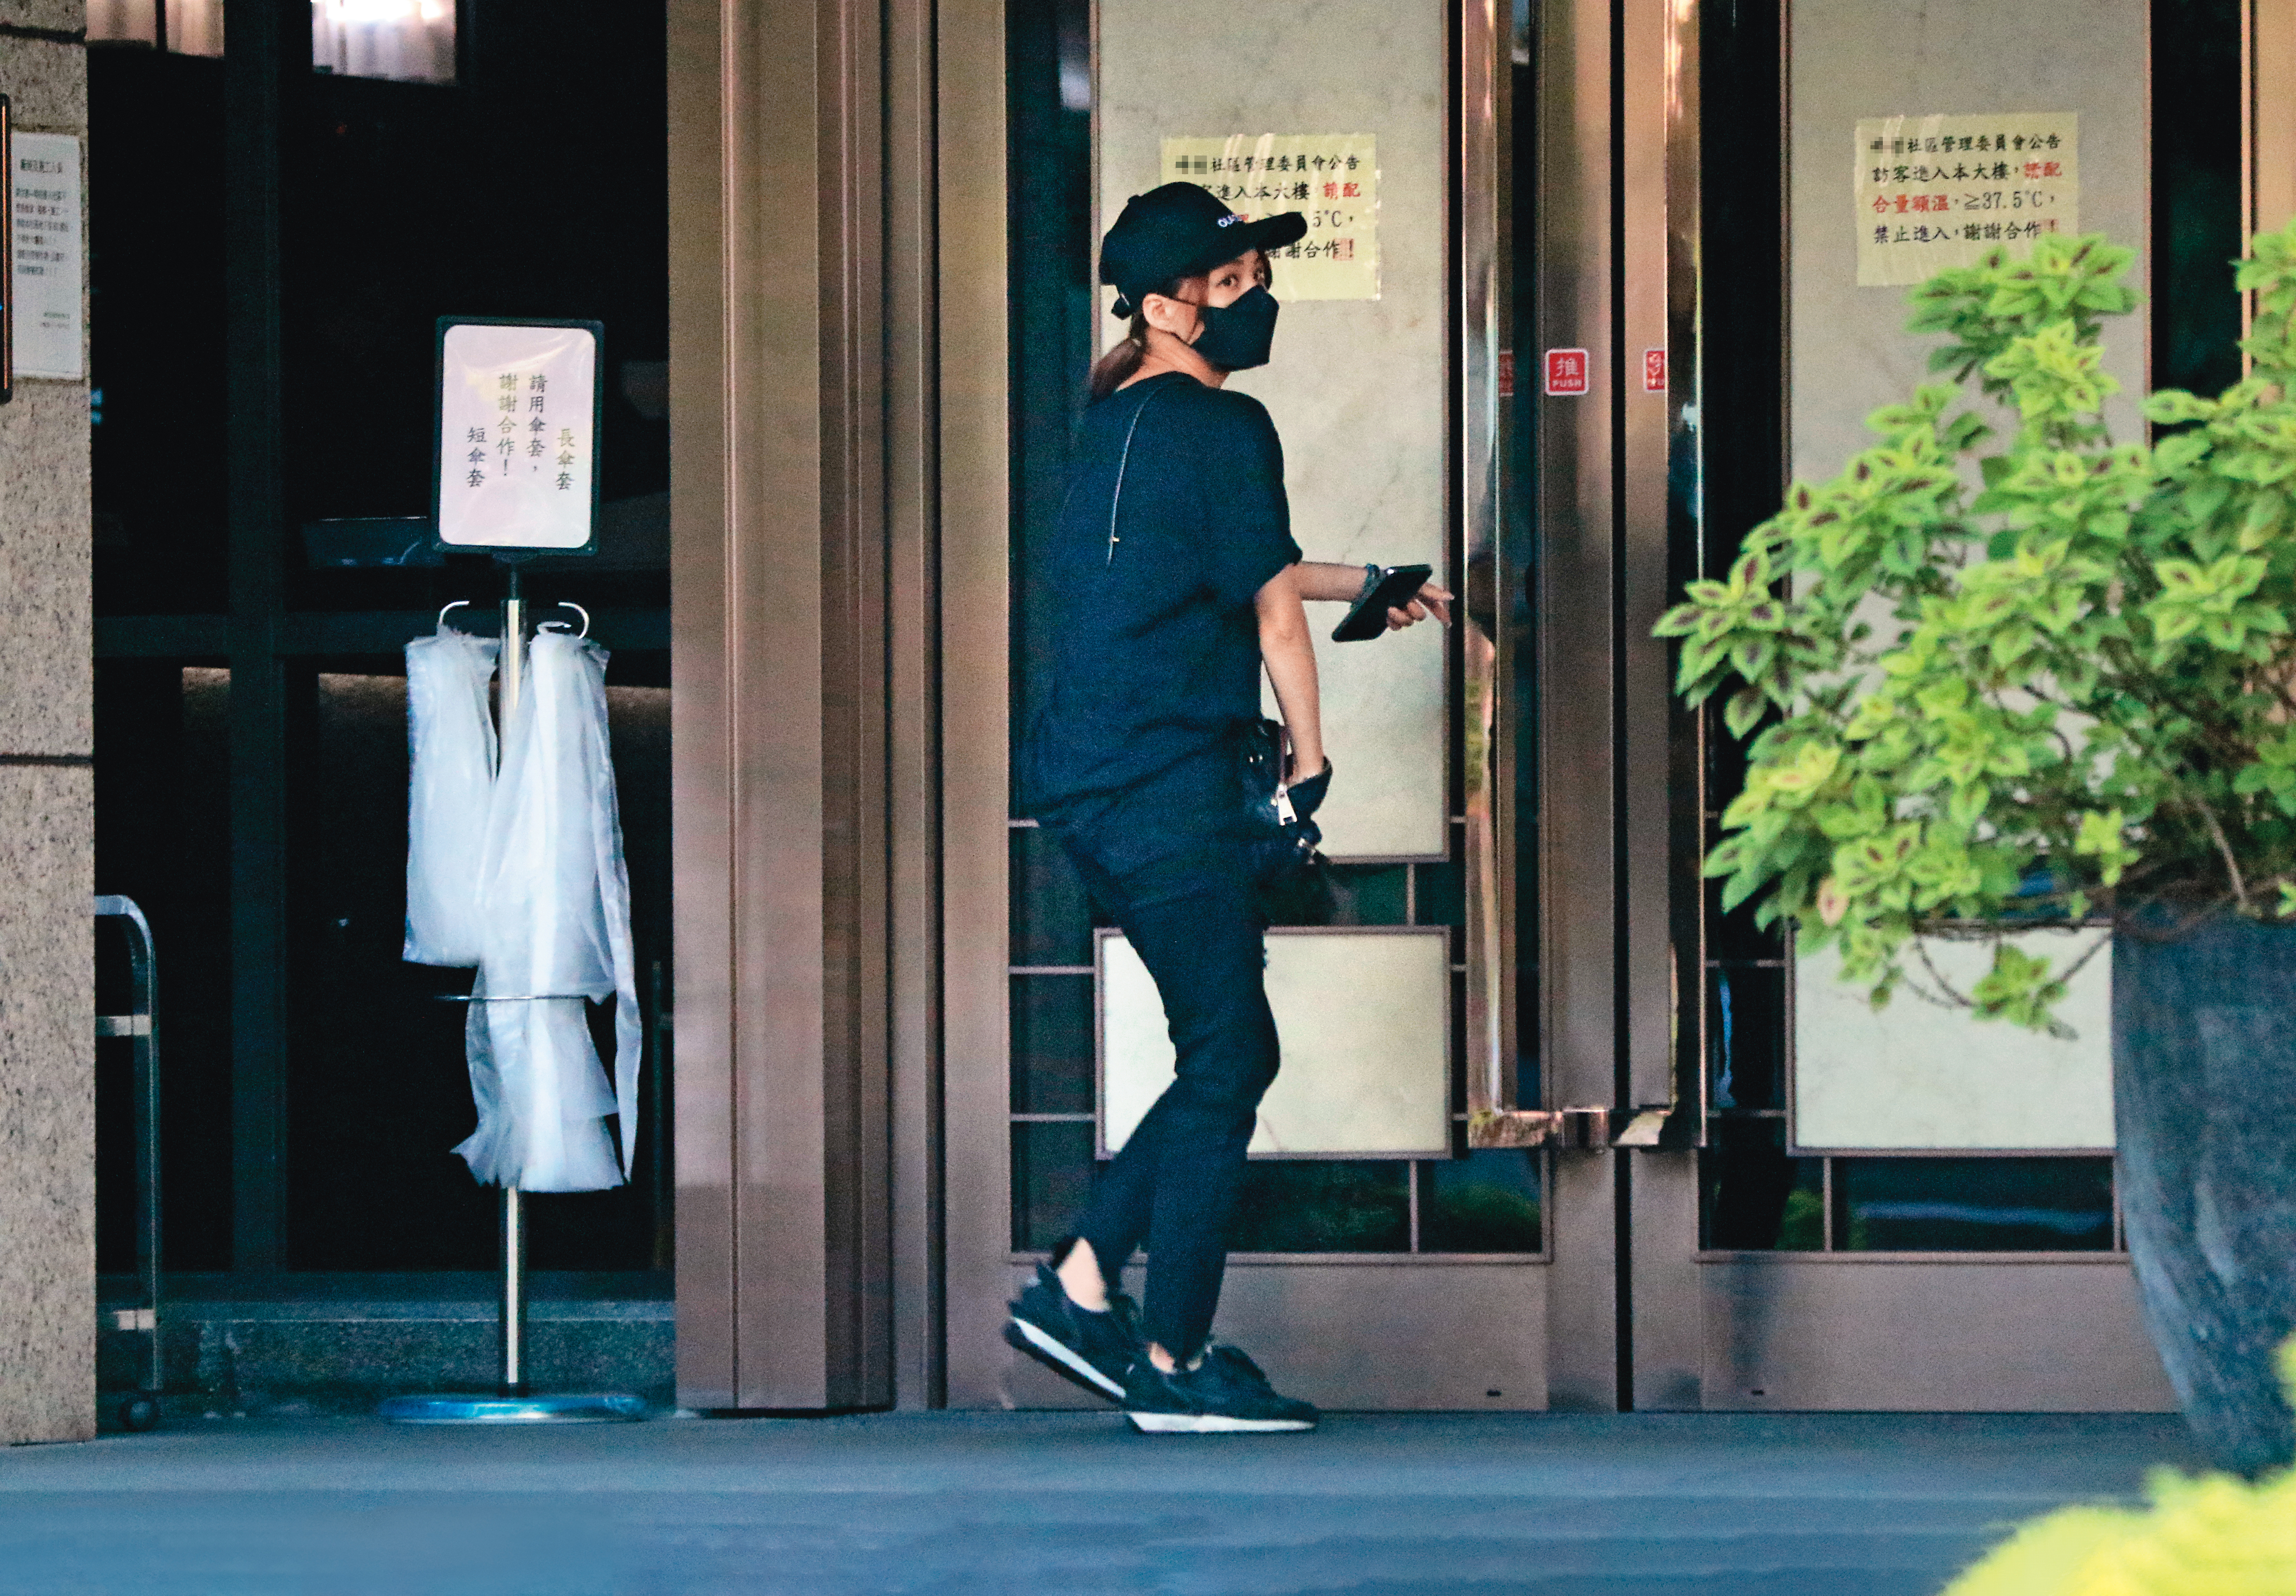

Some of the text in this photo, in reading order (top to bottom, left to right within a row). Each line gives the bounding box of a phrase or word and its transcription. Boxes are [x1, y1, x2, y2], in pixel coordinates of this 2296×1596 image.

[1870, 133, 2061, 155] 社區管理委員會公告
[1176, 154, 1360, 174] 社區管理委員會公告
[1556, 357, 1579, 377] 推
[1552, 379, 1582, 388] PUSH
[467, 427, 487, 488] 短傘套
[556, 428, 575, 491] 長傘套
